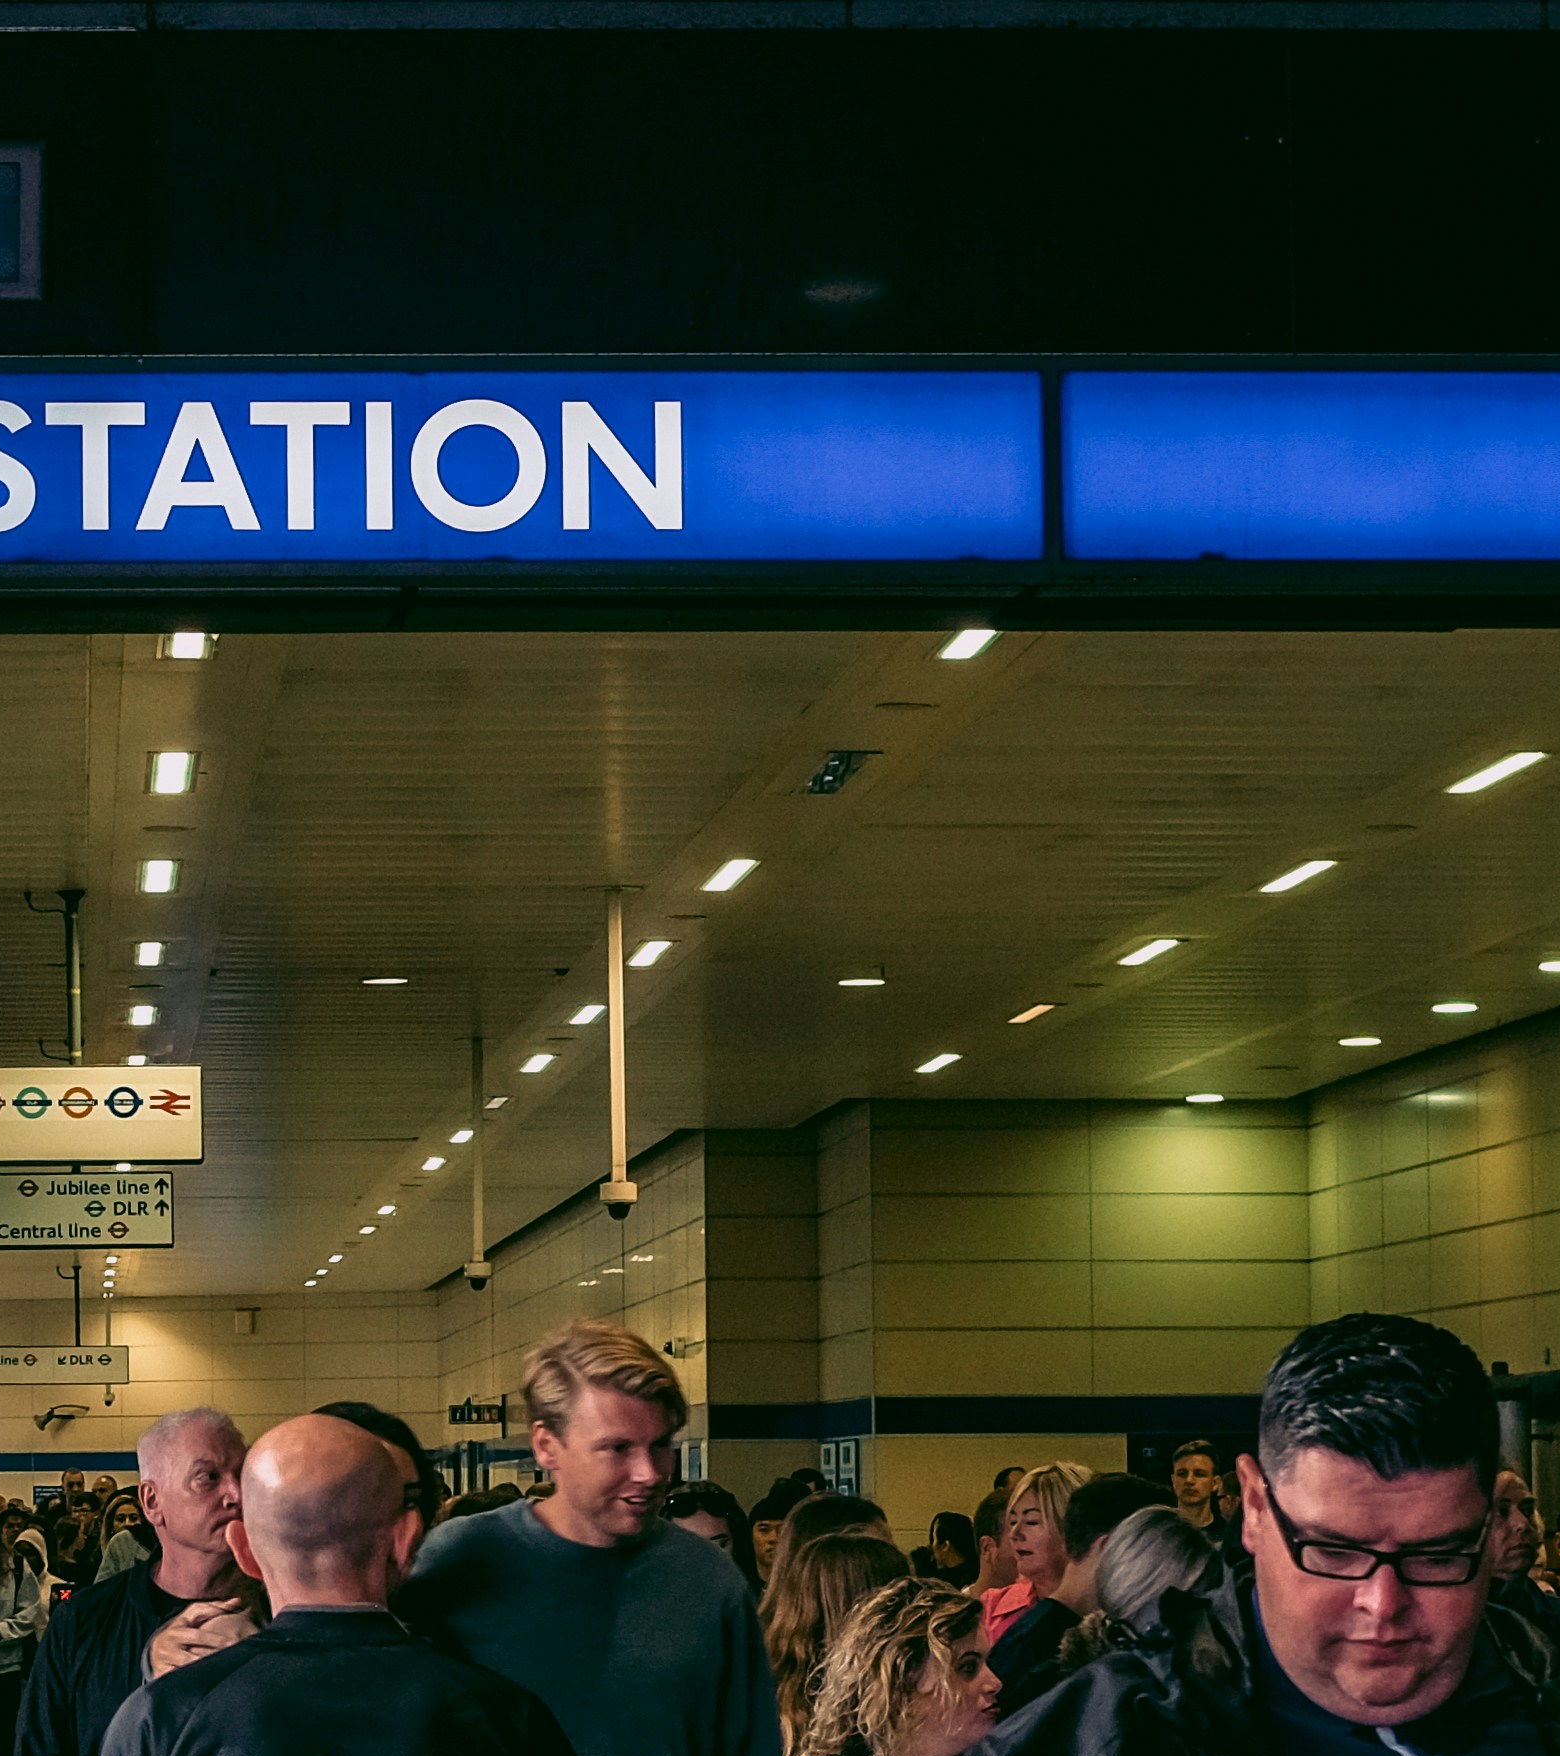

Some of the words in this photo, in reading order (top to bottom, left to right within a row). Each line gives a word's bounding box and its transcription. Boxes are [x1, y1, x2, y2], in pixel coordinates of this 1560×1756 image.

[46, 1180, 111, 1197] Jubilee
[117, 1179, 150, 1196] line
[113, 1201, 149, 1216] DLR
[68, 1223, 102, 1239] line
[69, 1356, 93, 1365] DLR
